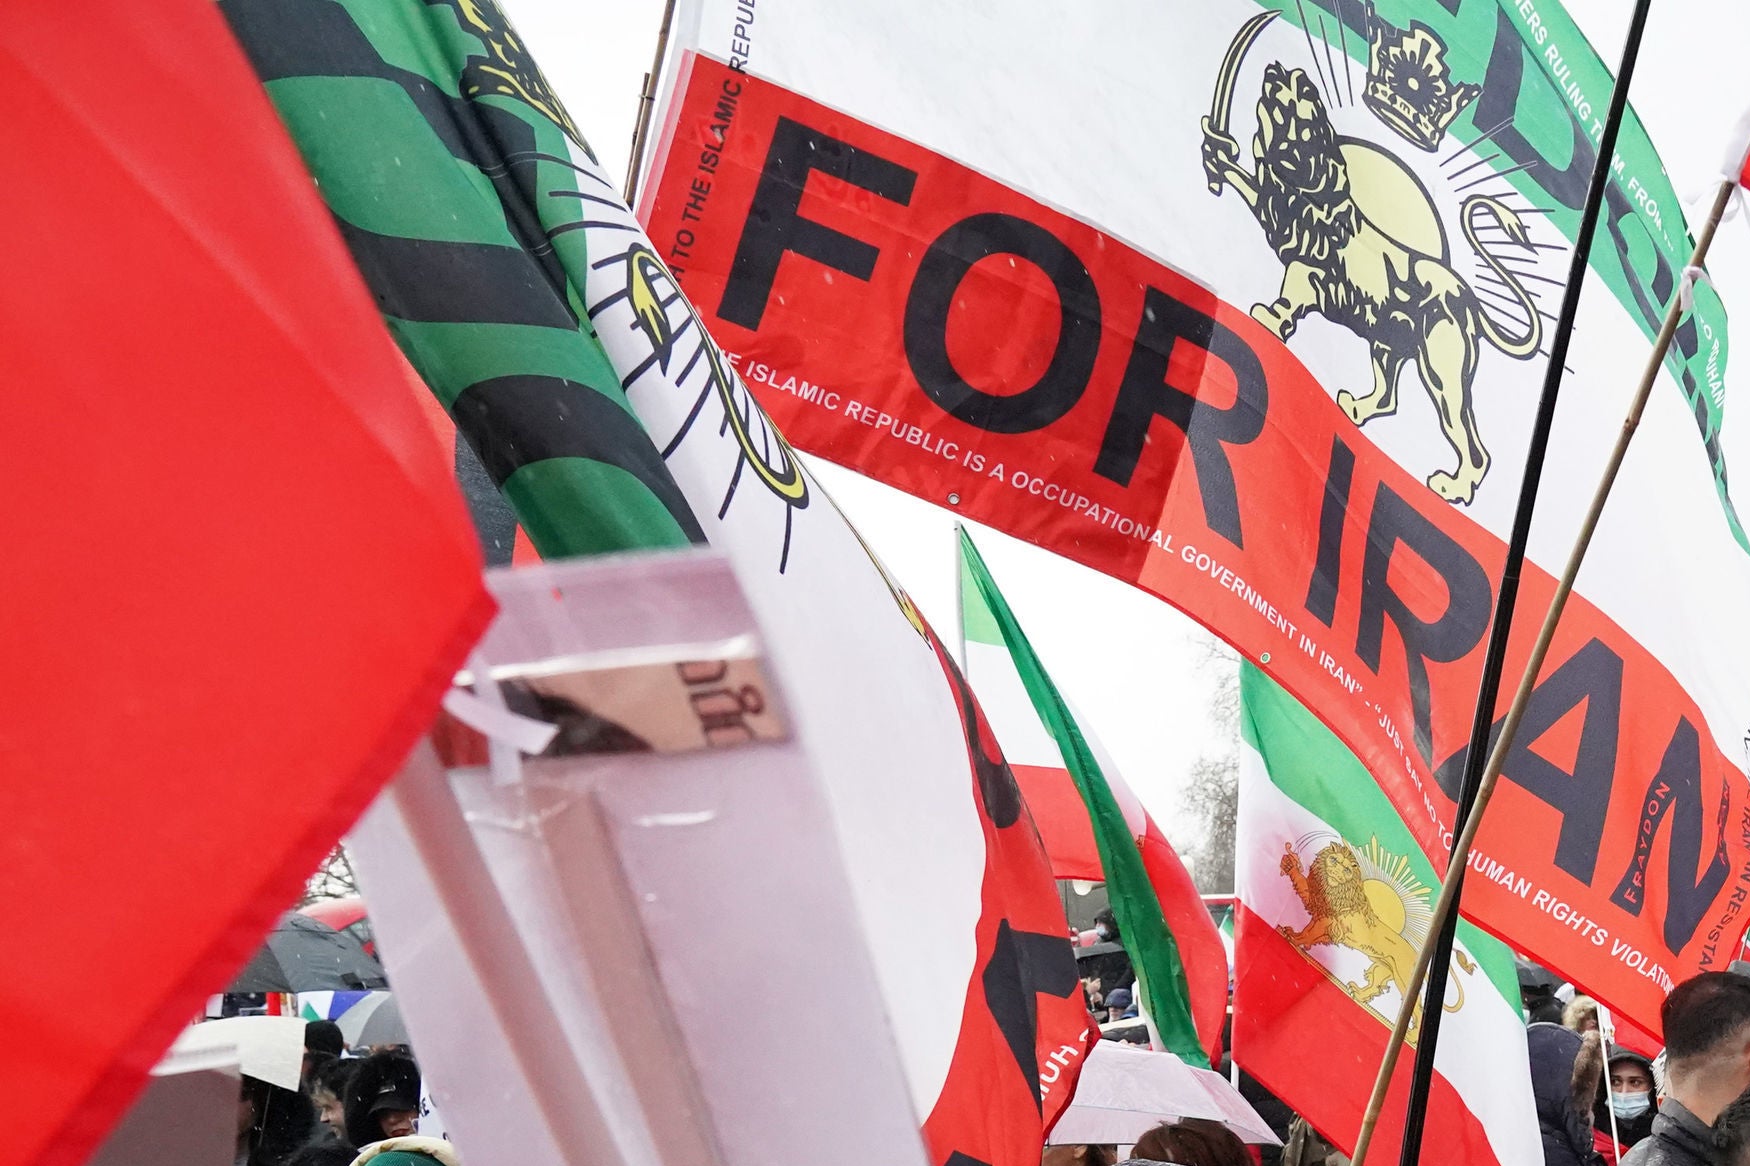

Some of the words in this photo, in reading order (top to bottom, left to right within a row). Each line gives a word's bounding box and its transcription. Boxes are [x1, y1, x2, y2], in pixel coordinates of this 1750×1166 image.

[698, 78, 742, 178] ISLAMIC
[1544, 44, 1591, 117] RULING
[1627, 177, 1662, 230] FROM
[671, 229, 695, 261] TO
[682, 173, 712, 228] THE
[717, 114, 1269, 551] FOR
[1304, 432, 1731, 958] IRAN
[746, 360, 841, 410] ISLAMIC
[844, 401, 960, 461] REPUBLIC
[963, 451, 987, 473] IS
[988, 463, 1006, 482] A
[1011, 470, 1175, 554] OCCUPATIONAL
[1181, 544, 1298, 640] GOVERNMENT
[1299, 633, 1317, 658] IN
[1405, 755, 1423, 792] SAY
[1423, 790, 1438, 824] NO
[1438, 820, 1455, 851] TO
[1532, 888, 1609, 946] RIGHTS
[1624, 780, 1670, 904] FRAYDON
